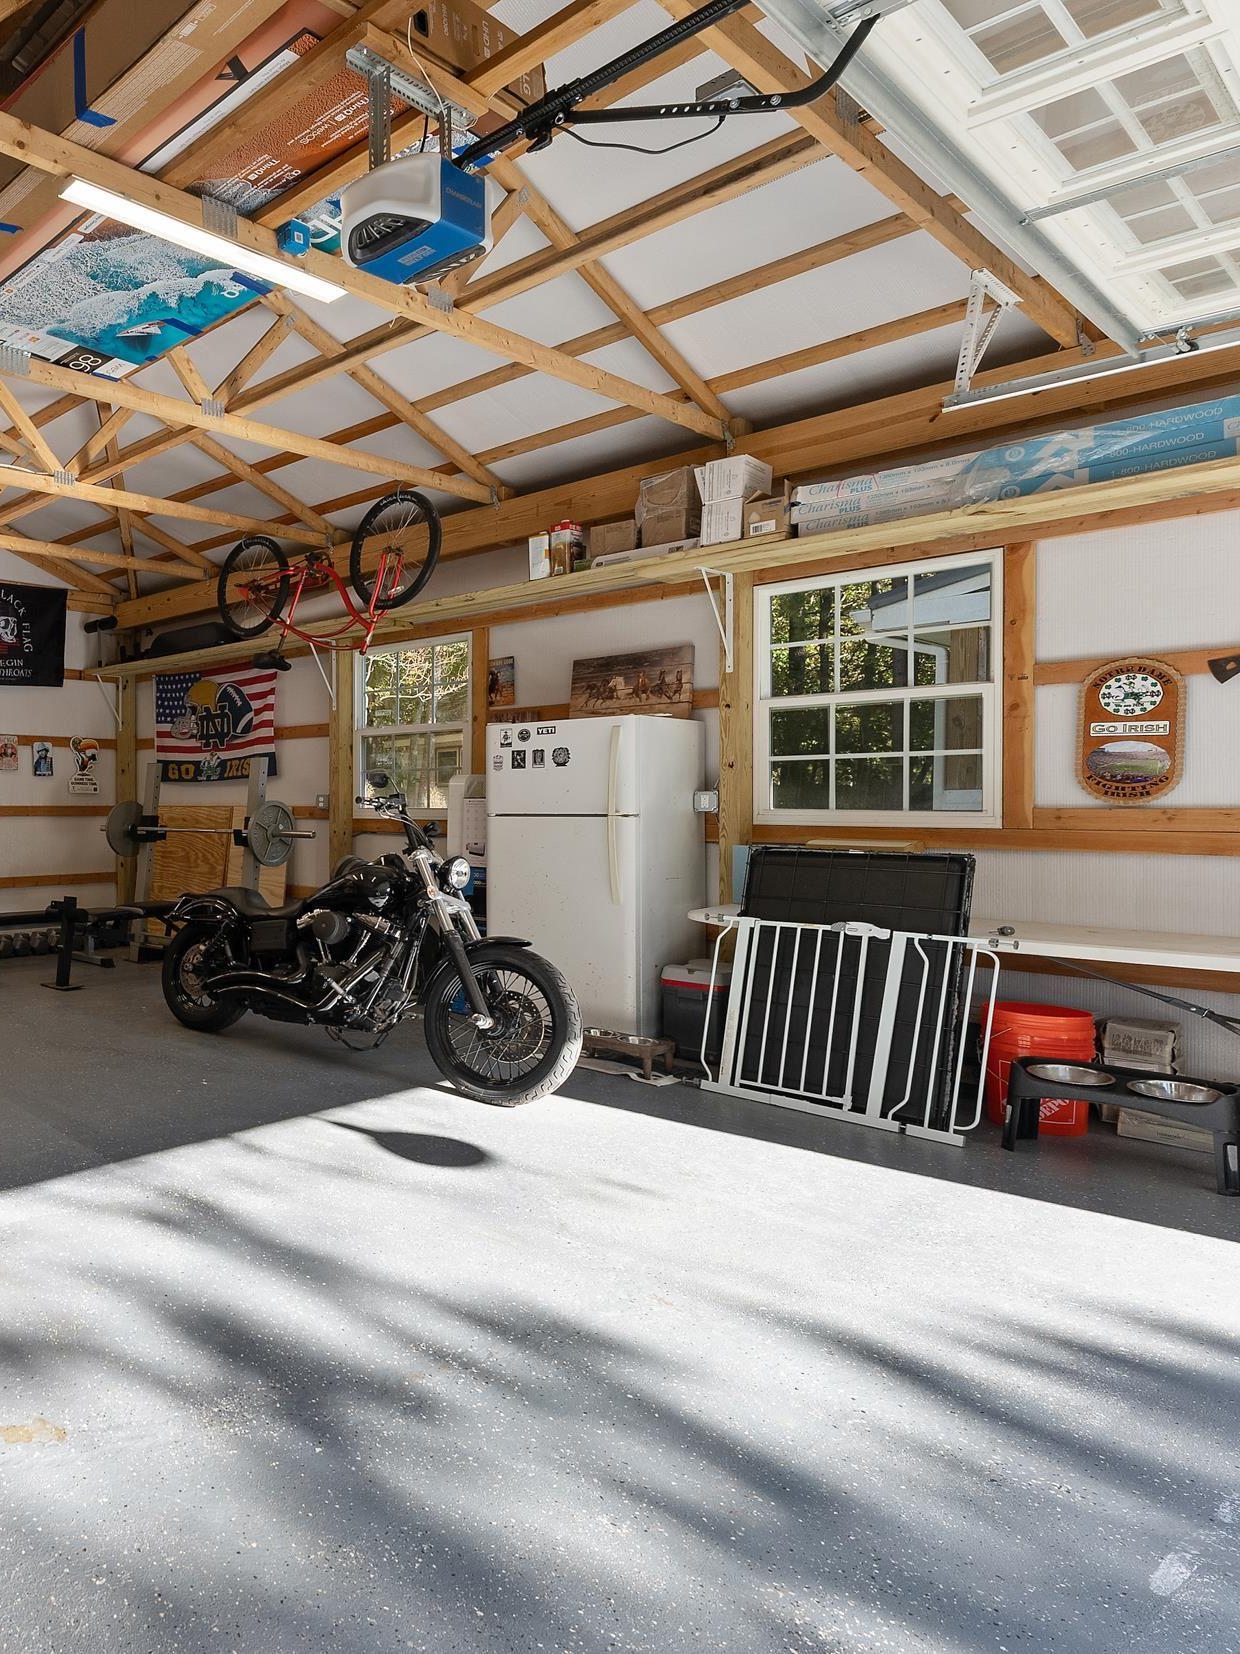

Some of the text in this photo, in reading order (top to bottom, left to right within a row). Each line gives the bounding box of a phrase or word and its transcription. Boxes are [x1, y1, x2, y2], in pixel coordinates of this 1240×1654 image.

[522, 75, 531, 96] LG
[69, 354, 102, 373] 86
[1111, 450, 1217, 477] 1-800-HARDWOOD
[850, 484, 873, 495] PLUS
[798, 497, 862, 516] Charisma
[839, 504, 862, 514] PLUS
[806, 514, 870, 533] Charisma
[22, 622, 34, 653] FLAG
[1092, 666, 1173, 689] NOTRE DAME
[168, 758, 251, 780] GO IRIS
[1103, 790, 1151, 798] IRISH
[1038, 1098, 1070, 1121] DEPO
